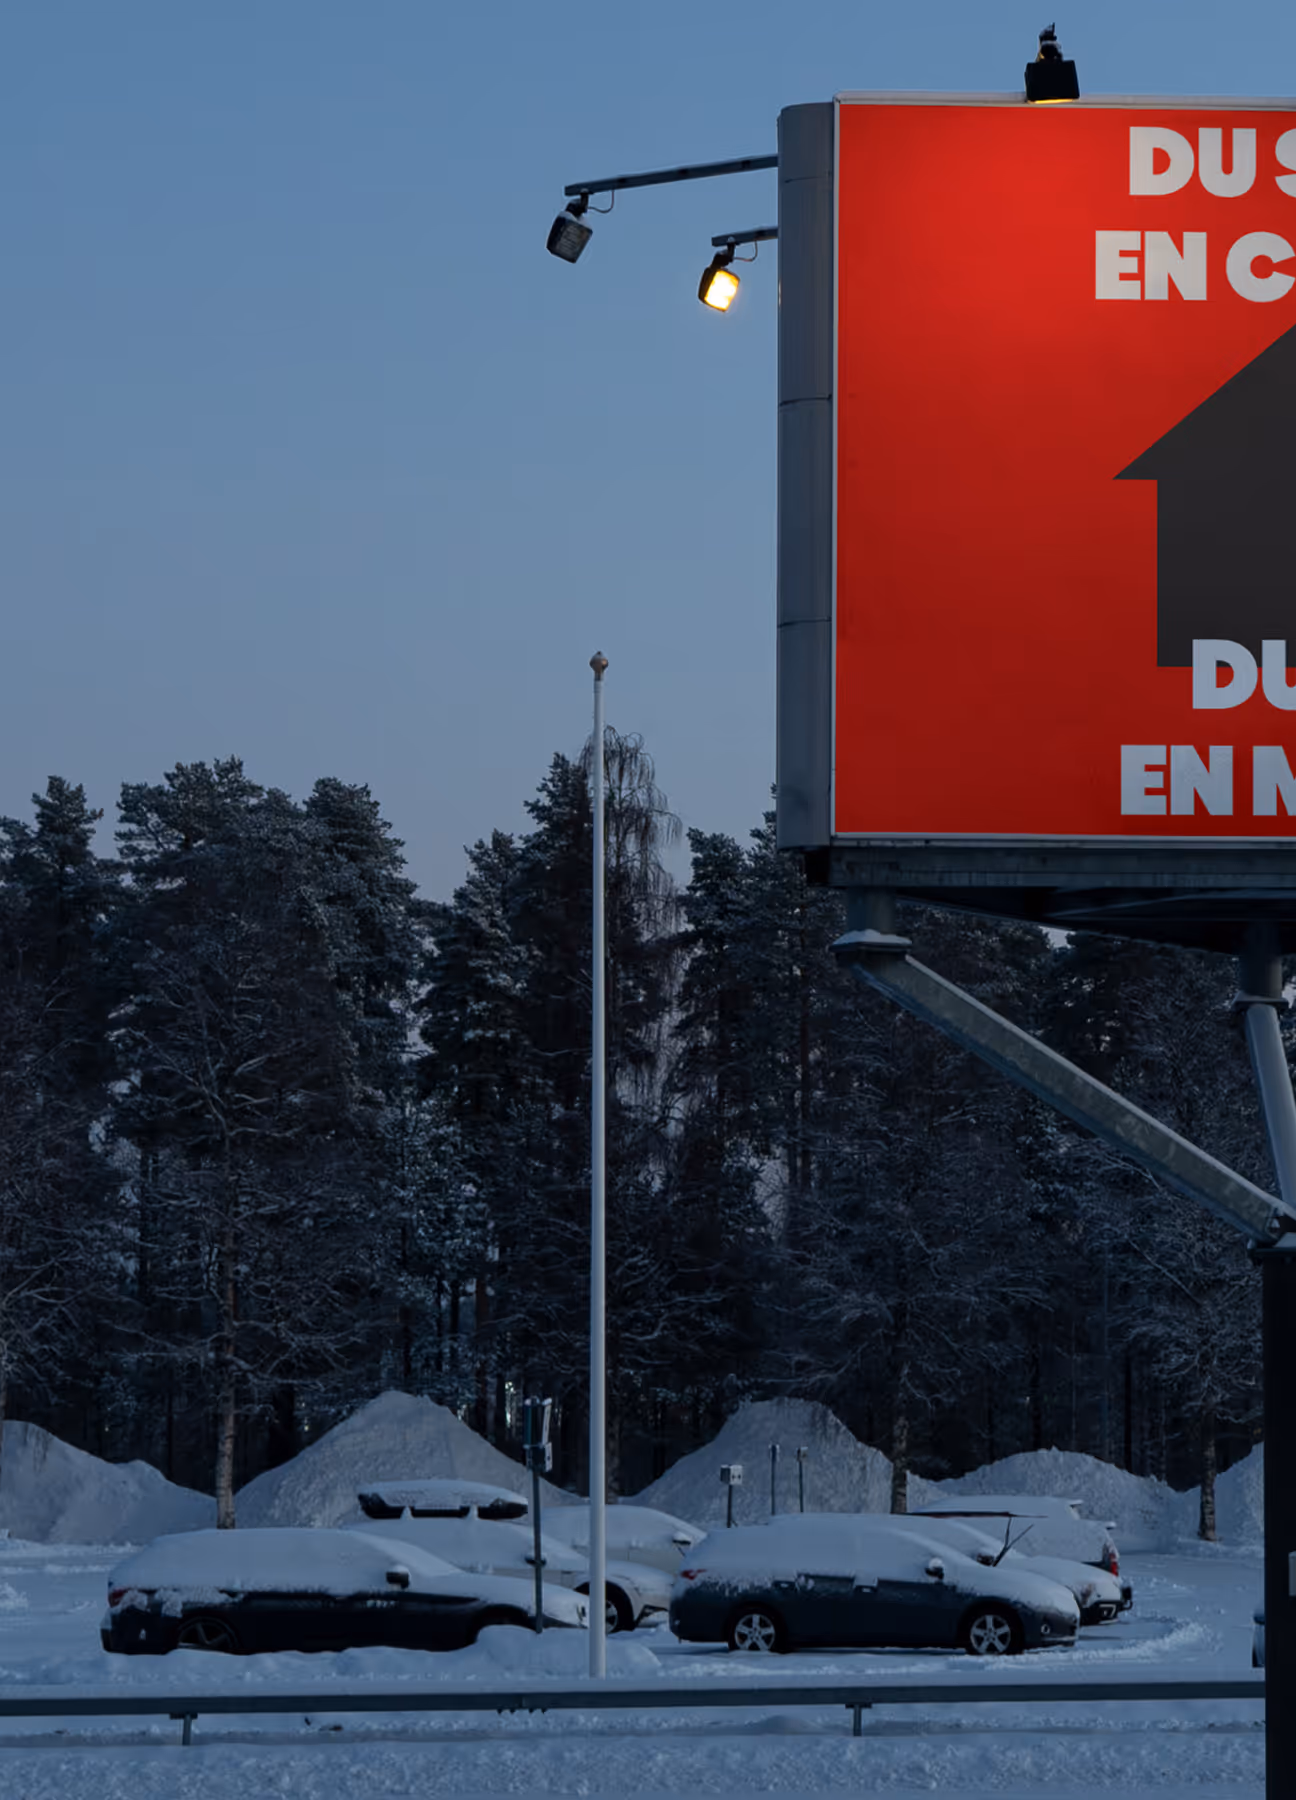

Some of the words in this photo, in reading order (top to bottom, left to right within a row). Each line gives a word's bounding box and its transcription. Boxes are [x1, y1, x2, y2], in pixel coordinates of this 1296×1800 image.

[1129, 126, 1256, 198] DU
[1095, 230, 1207, 300] EN
[1120, 745, 1233, 816] EN
